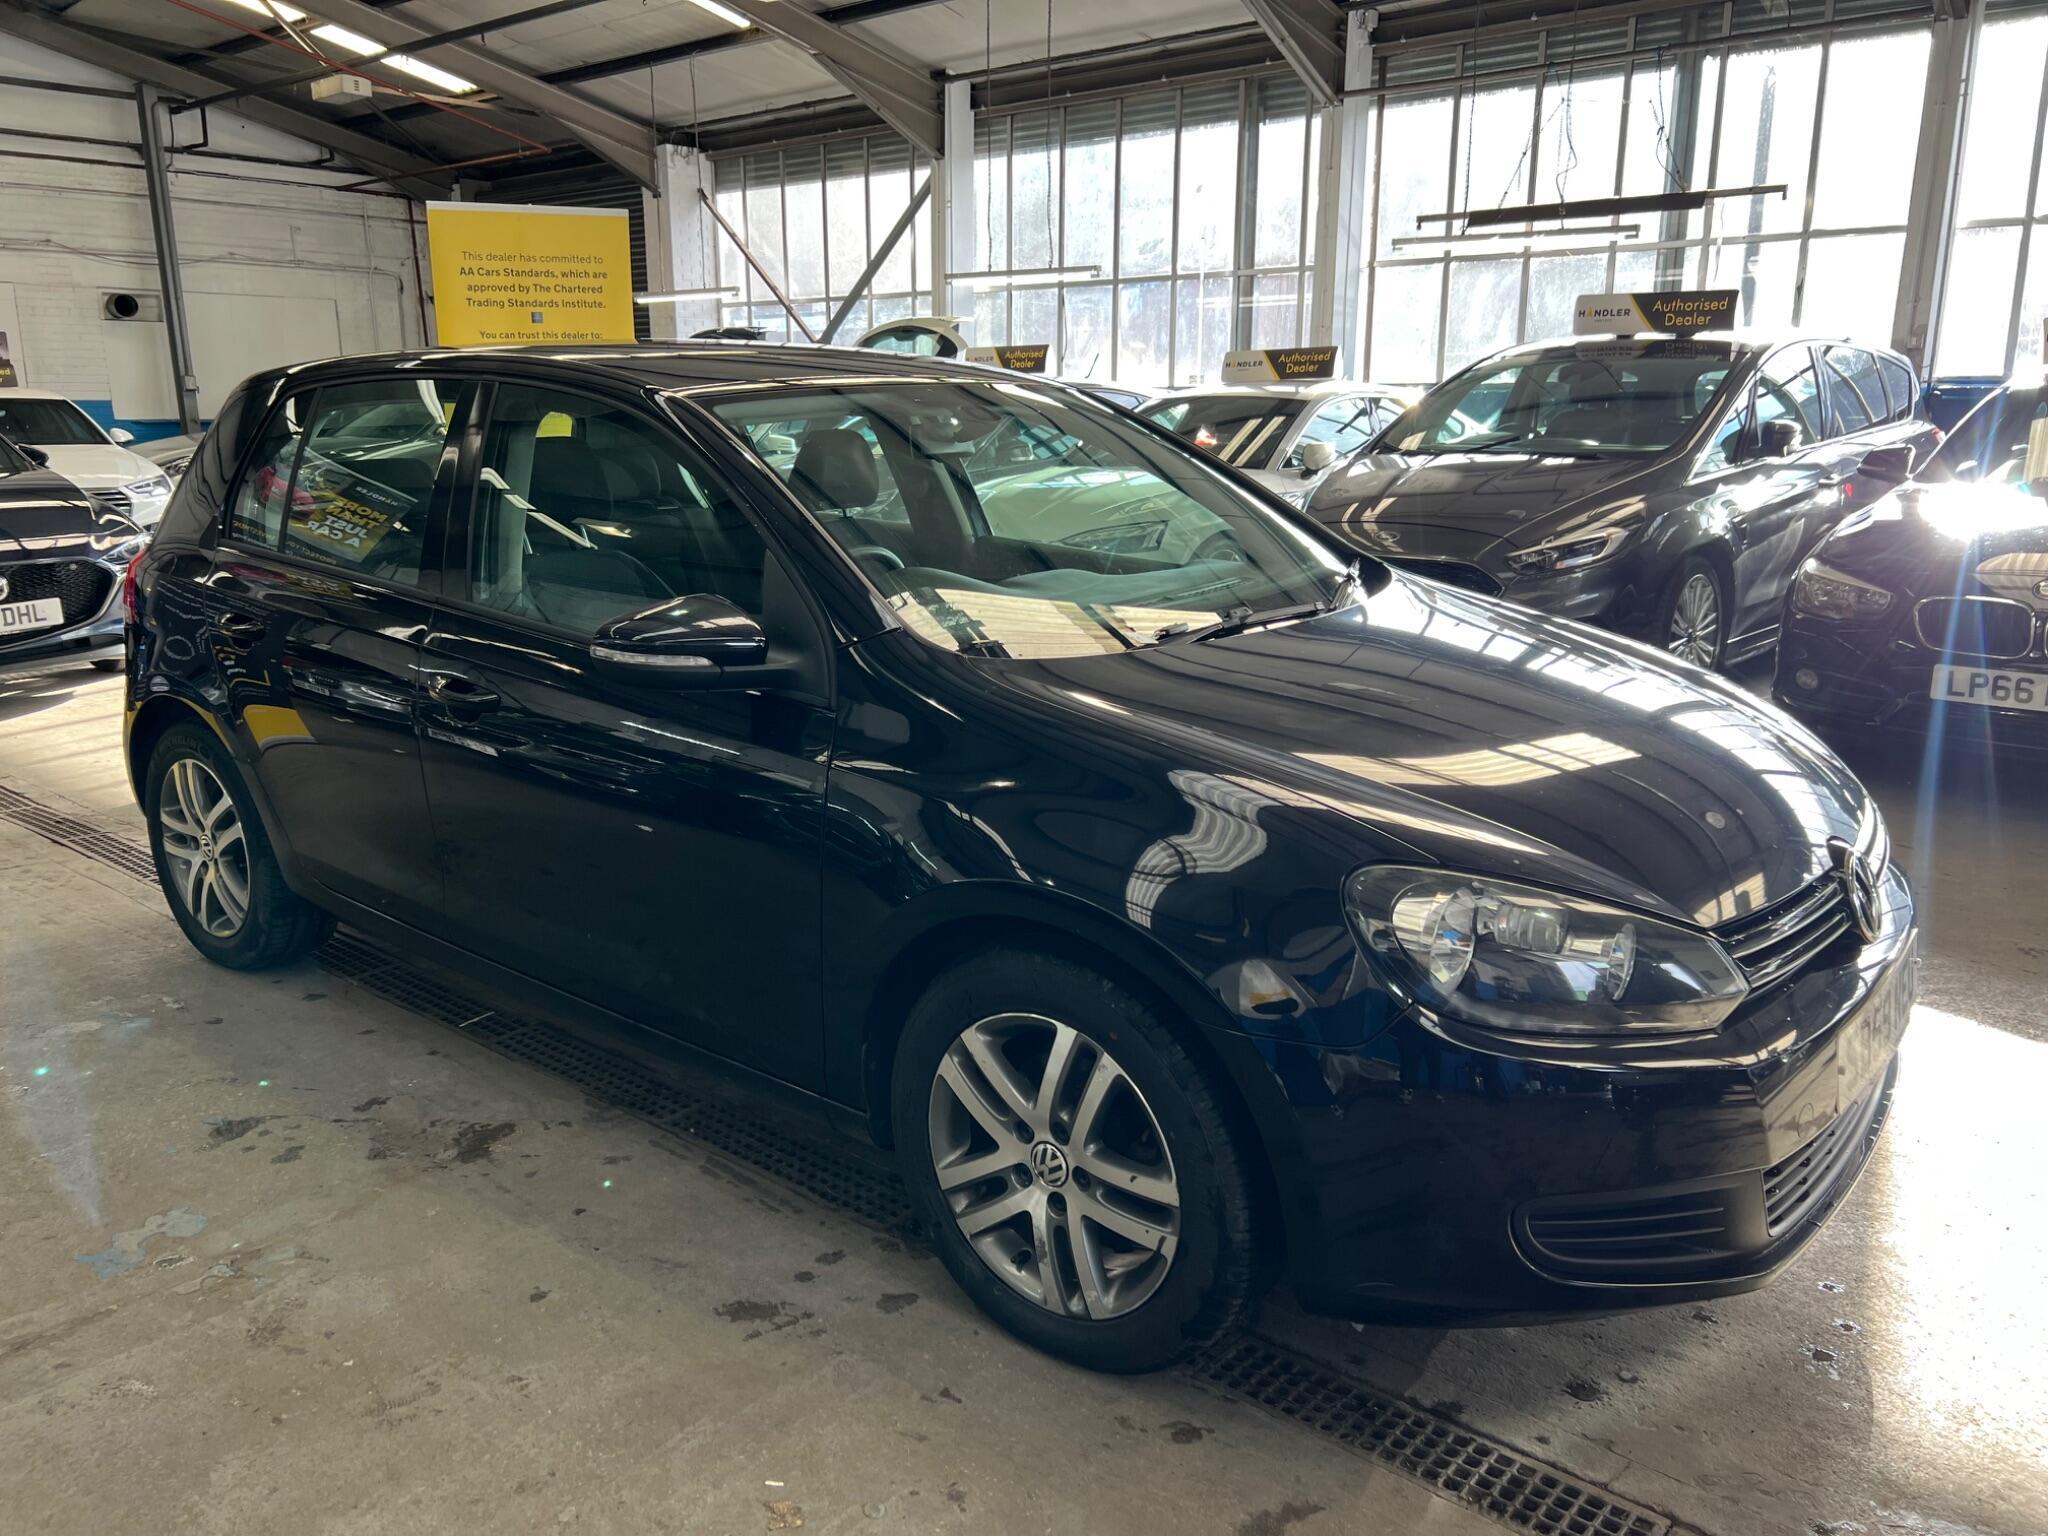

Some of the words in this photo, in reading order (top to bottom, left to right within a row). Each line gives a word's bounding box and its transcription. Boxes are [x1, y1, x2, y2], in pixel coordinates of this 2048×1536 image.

[461, 250, 484, 261] This
[485, 252, 517, 262] dealer
[519, 253, 537, 263] has
[539, 255, 592, 264] committed
[593, 255, 604, 264] to
[459, 267, 475, 276] AA
[476, 267, 501, 277] Cars
[503, 268, 559, 279] Standards,
[560, 269, 590, 279] which
[592, 271, 608, 279] are
[467, 283, 516, 294] approved
[518, 284, 530, 295] by
[532, 283, 551, 293] The
[553, 284, 604, 294] Chartered
[465, 298, 505, 309] Trading
[507, 298, 560, 308] Standards
[562, 299, 607, 309] Institute.
[1652, 297, 1728, 312] Authorised
[1664, 313, 1712, 326] Dealer
[480, 330, 497, 340] You
[498, 332, 516, 340] can
[517, 331, 541, 340] trust
[542, 331, 560, 340] this
[561, 331, 589, 340] dealer
[1005, 349, 1044, 359] Authorised
[1278, 351, 1331, 363] Authorised
[1010, 359, 1035, 369] Dealer
[1286, 363, 1319, 373] Dealer
[1, 603, 47, 627] DHL
[1947, 669, 2035, 704] LP66
